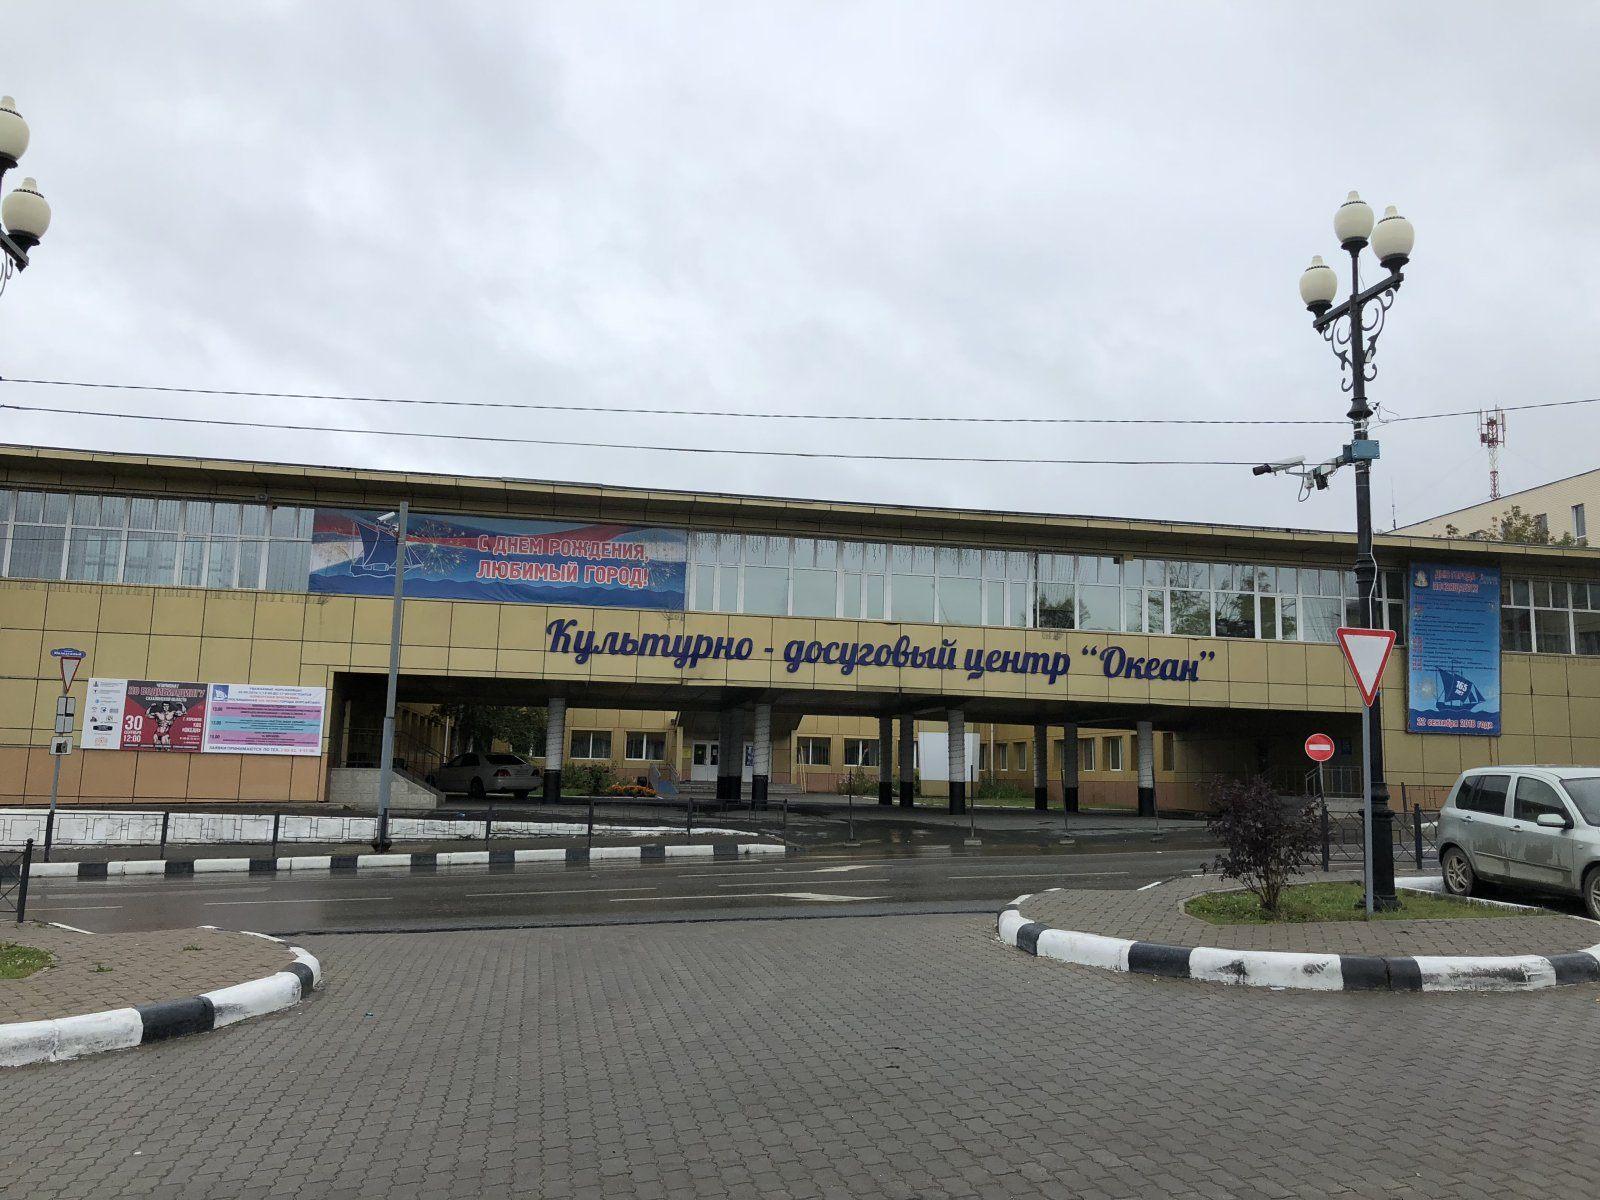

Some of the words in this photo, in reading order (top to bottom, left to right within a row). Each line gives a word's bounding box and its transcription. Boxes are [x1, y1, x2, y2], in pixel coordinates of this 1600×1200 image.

[478, 535, 489, 552] С
[493, 536, 544, 555] ДНЕМ
[549, 539, 651, 562] РОЖДЕНИЯ,
[476, 560, 579, 582] ЛЮБИМЫЙ
[584, 565, 649, 588] ГОРОД!
[545, 618, 754, 669] Культурно
[783, 635, 957, 675] досуговый
[964, 649, 1071, 685] центр
[1456, 680, 1468, 692] 165
[125, 715, 143, 731] 30
[123, 735, 141, 743] 12:00
